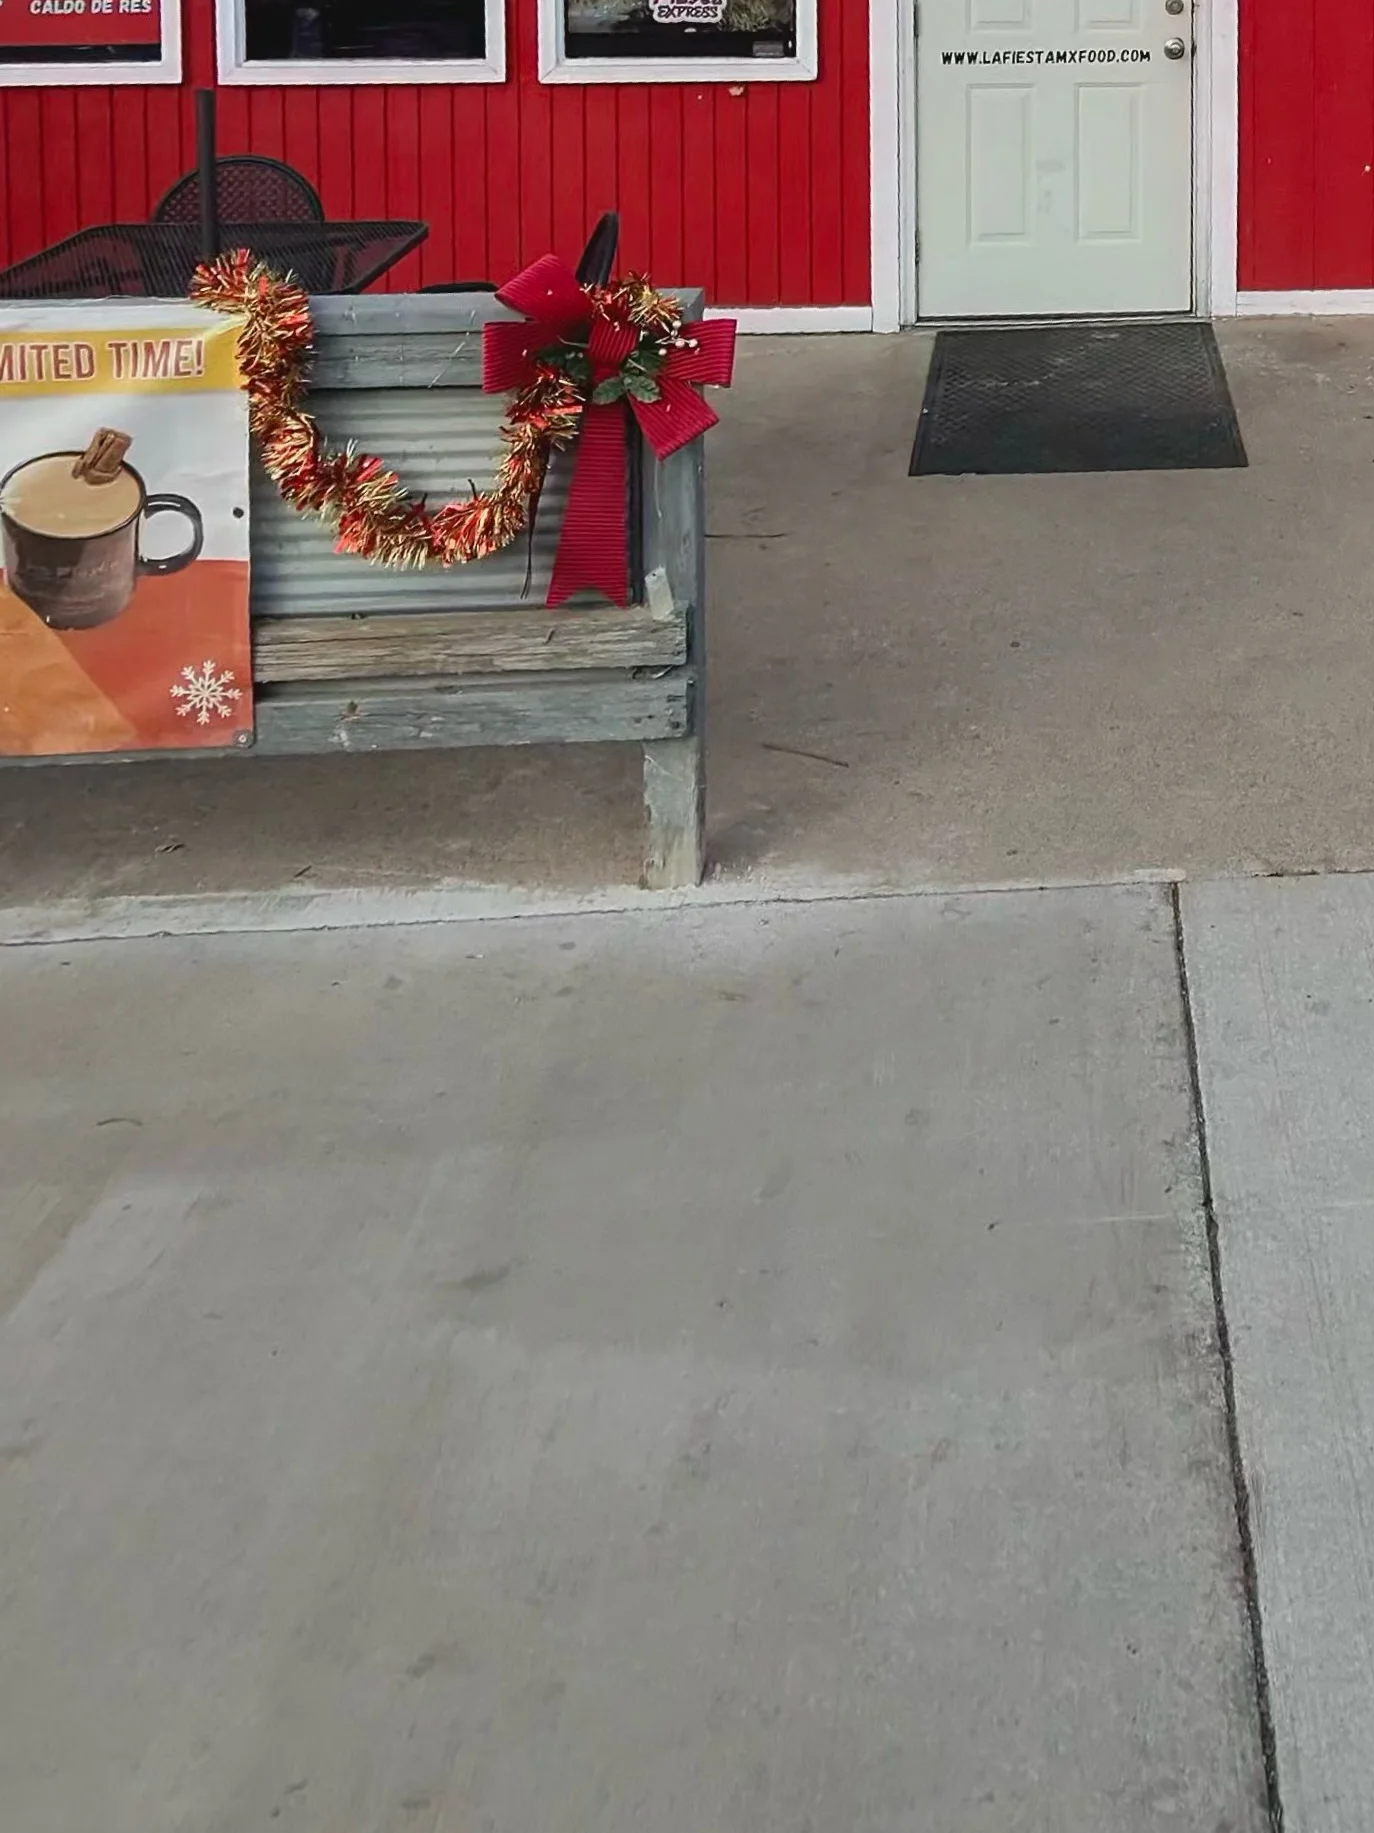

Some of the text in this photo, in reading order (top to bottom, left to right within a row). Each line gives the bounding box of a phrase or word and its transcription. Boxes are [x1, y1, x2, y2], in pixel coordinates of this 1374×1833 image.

[30, 0, 152, 15] CALDO DE RES
[657, 5, 719, 19] EXPRESS
[941, 49, 1152, 66] WWW.LAFIESTAMXFOOD.COM
[107, 339, 205, 380] TIME!
